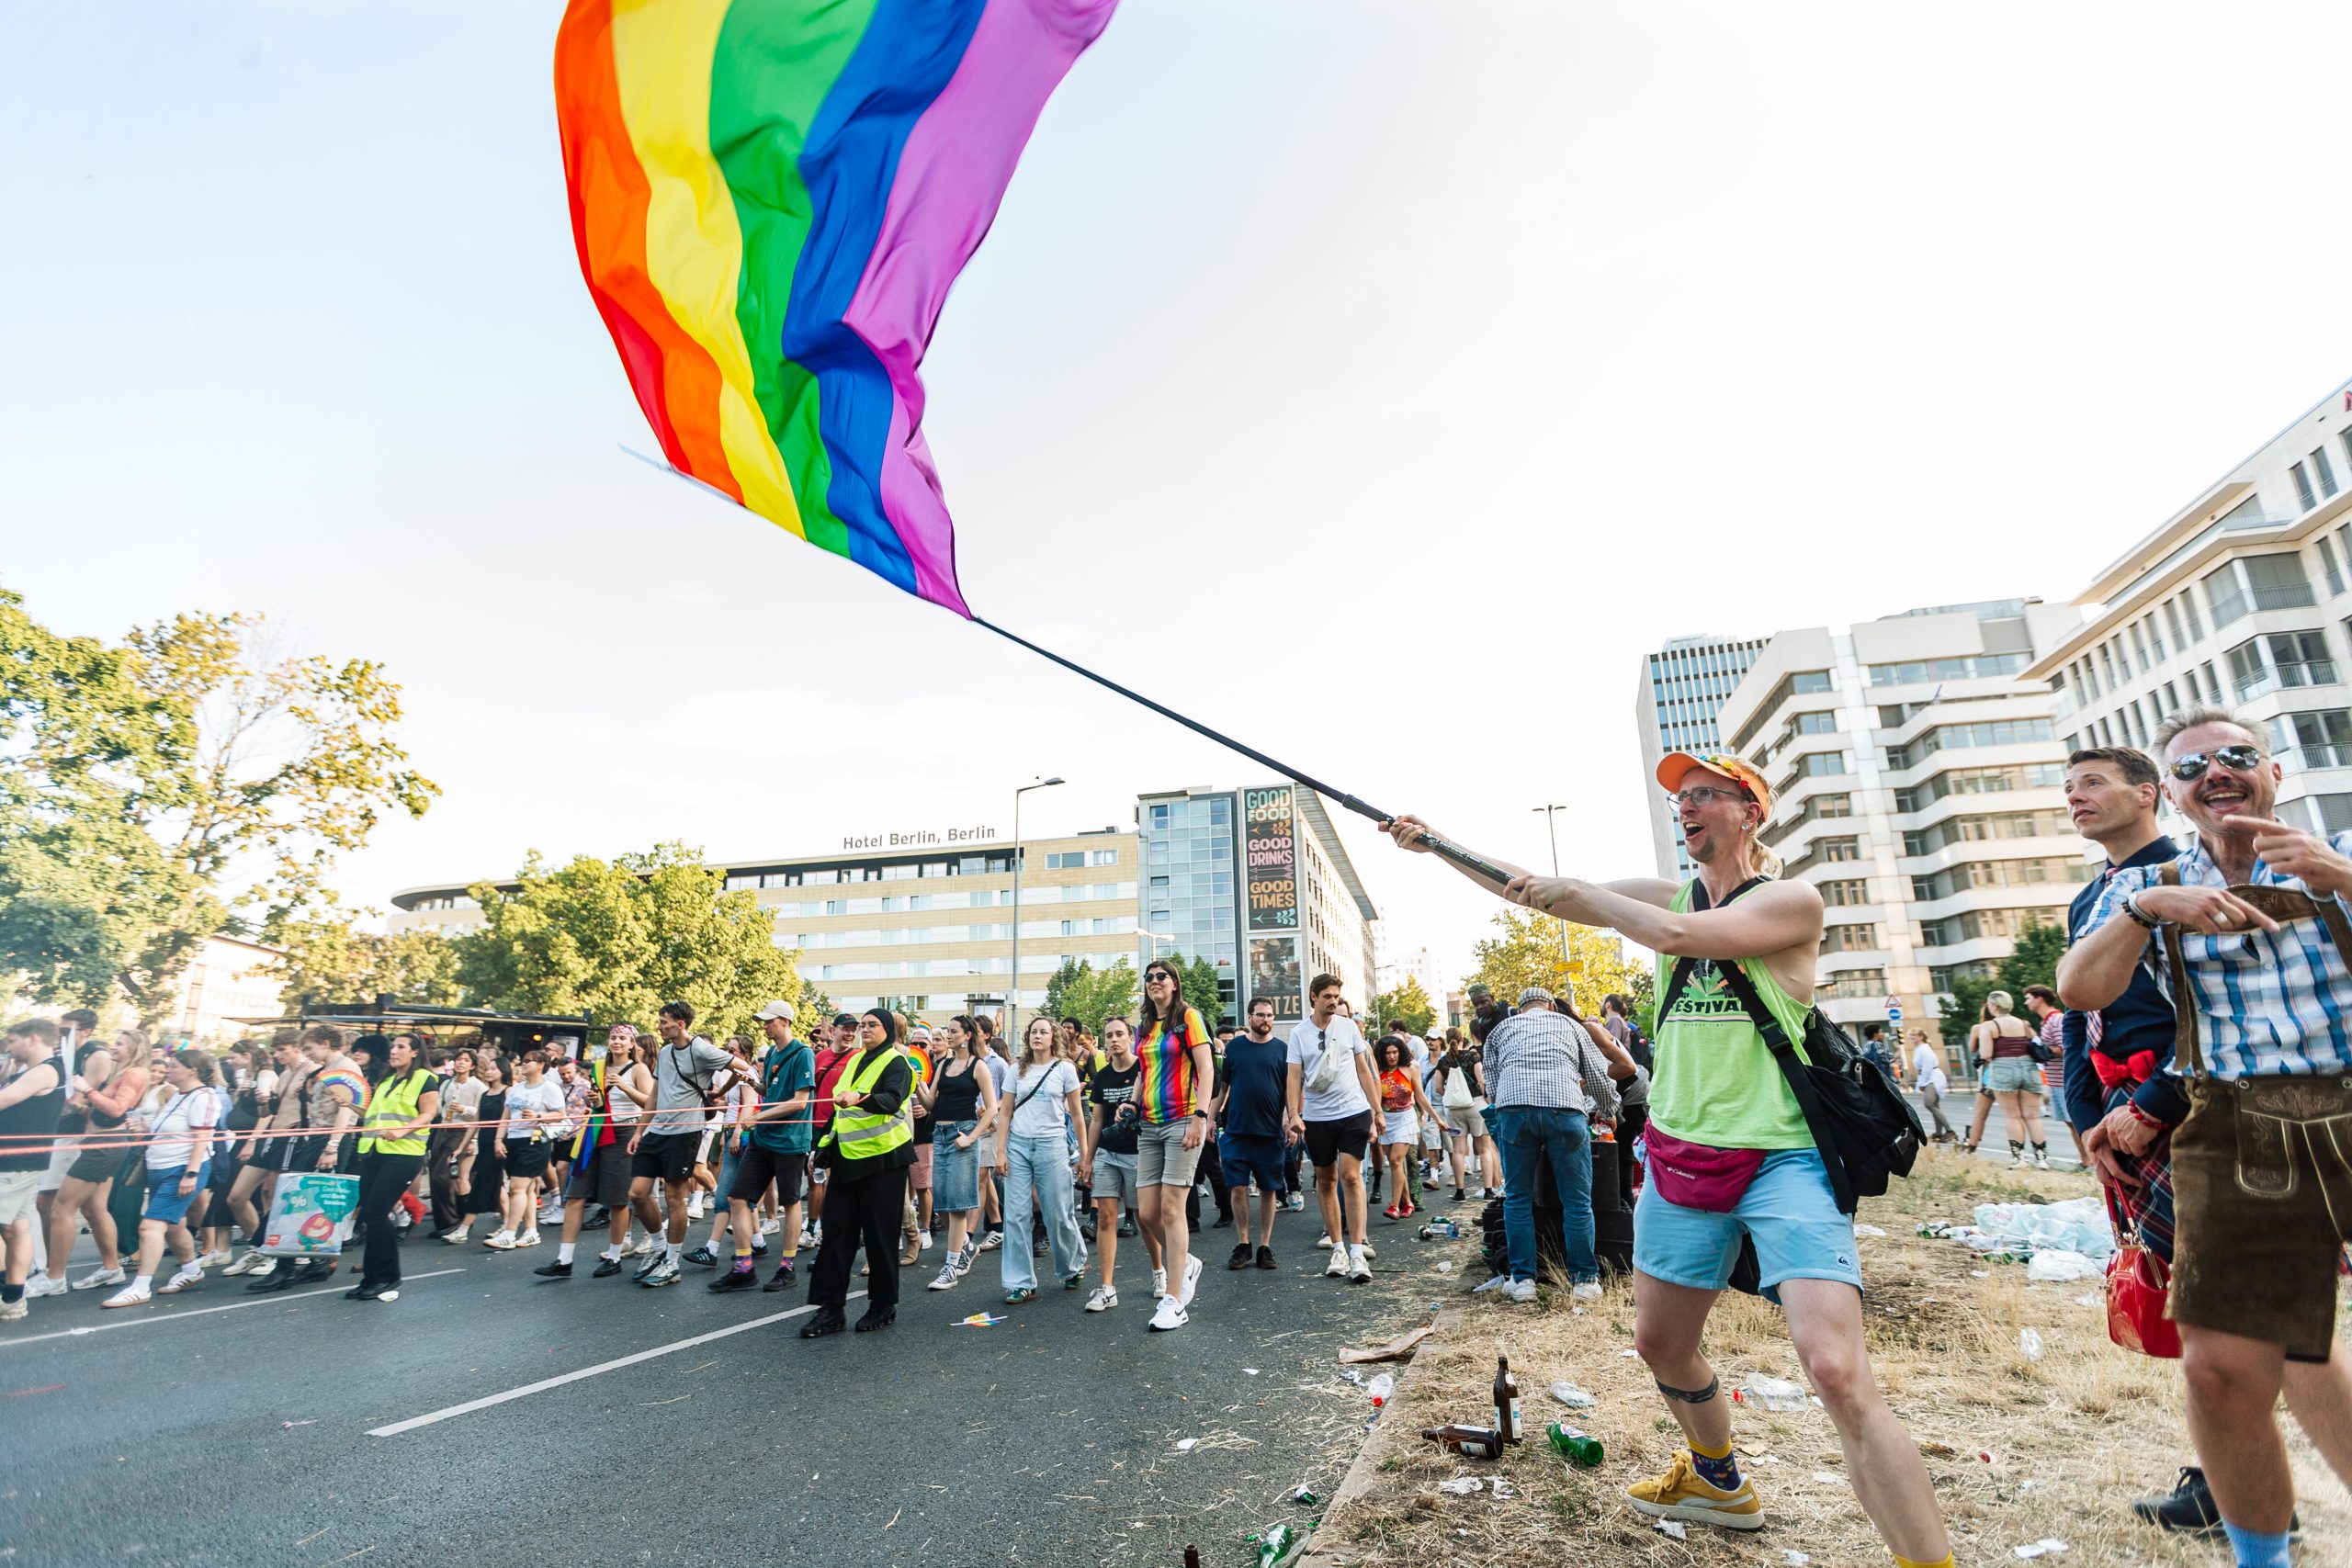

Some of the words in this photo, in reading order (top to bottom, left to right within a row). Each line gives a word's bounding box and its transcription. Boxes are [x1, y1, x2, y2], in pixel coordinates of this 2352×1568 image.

[1247, 789, 1291, 809] GOOD
[1248, 808, 1292, 823] FOOD
[843, 834, 882, 849] Hotel
[889, 830, 941, 845] Berlin,
[947, 825, 995, 841] Berlin
[1248, 837, 1293, 852] GOOD
[1249, 850, 1294, 866] DRINKS
[1250, 880, 1295, 894] GOOD
[1250, 892, 1295, 909] TIMES
[1268, 995, 1301, 1015] TZE
